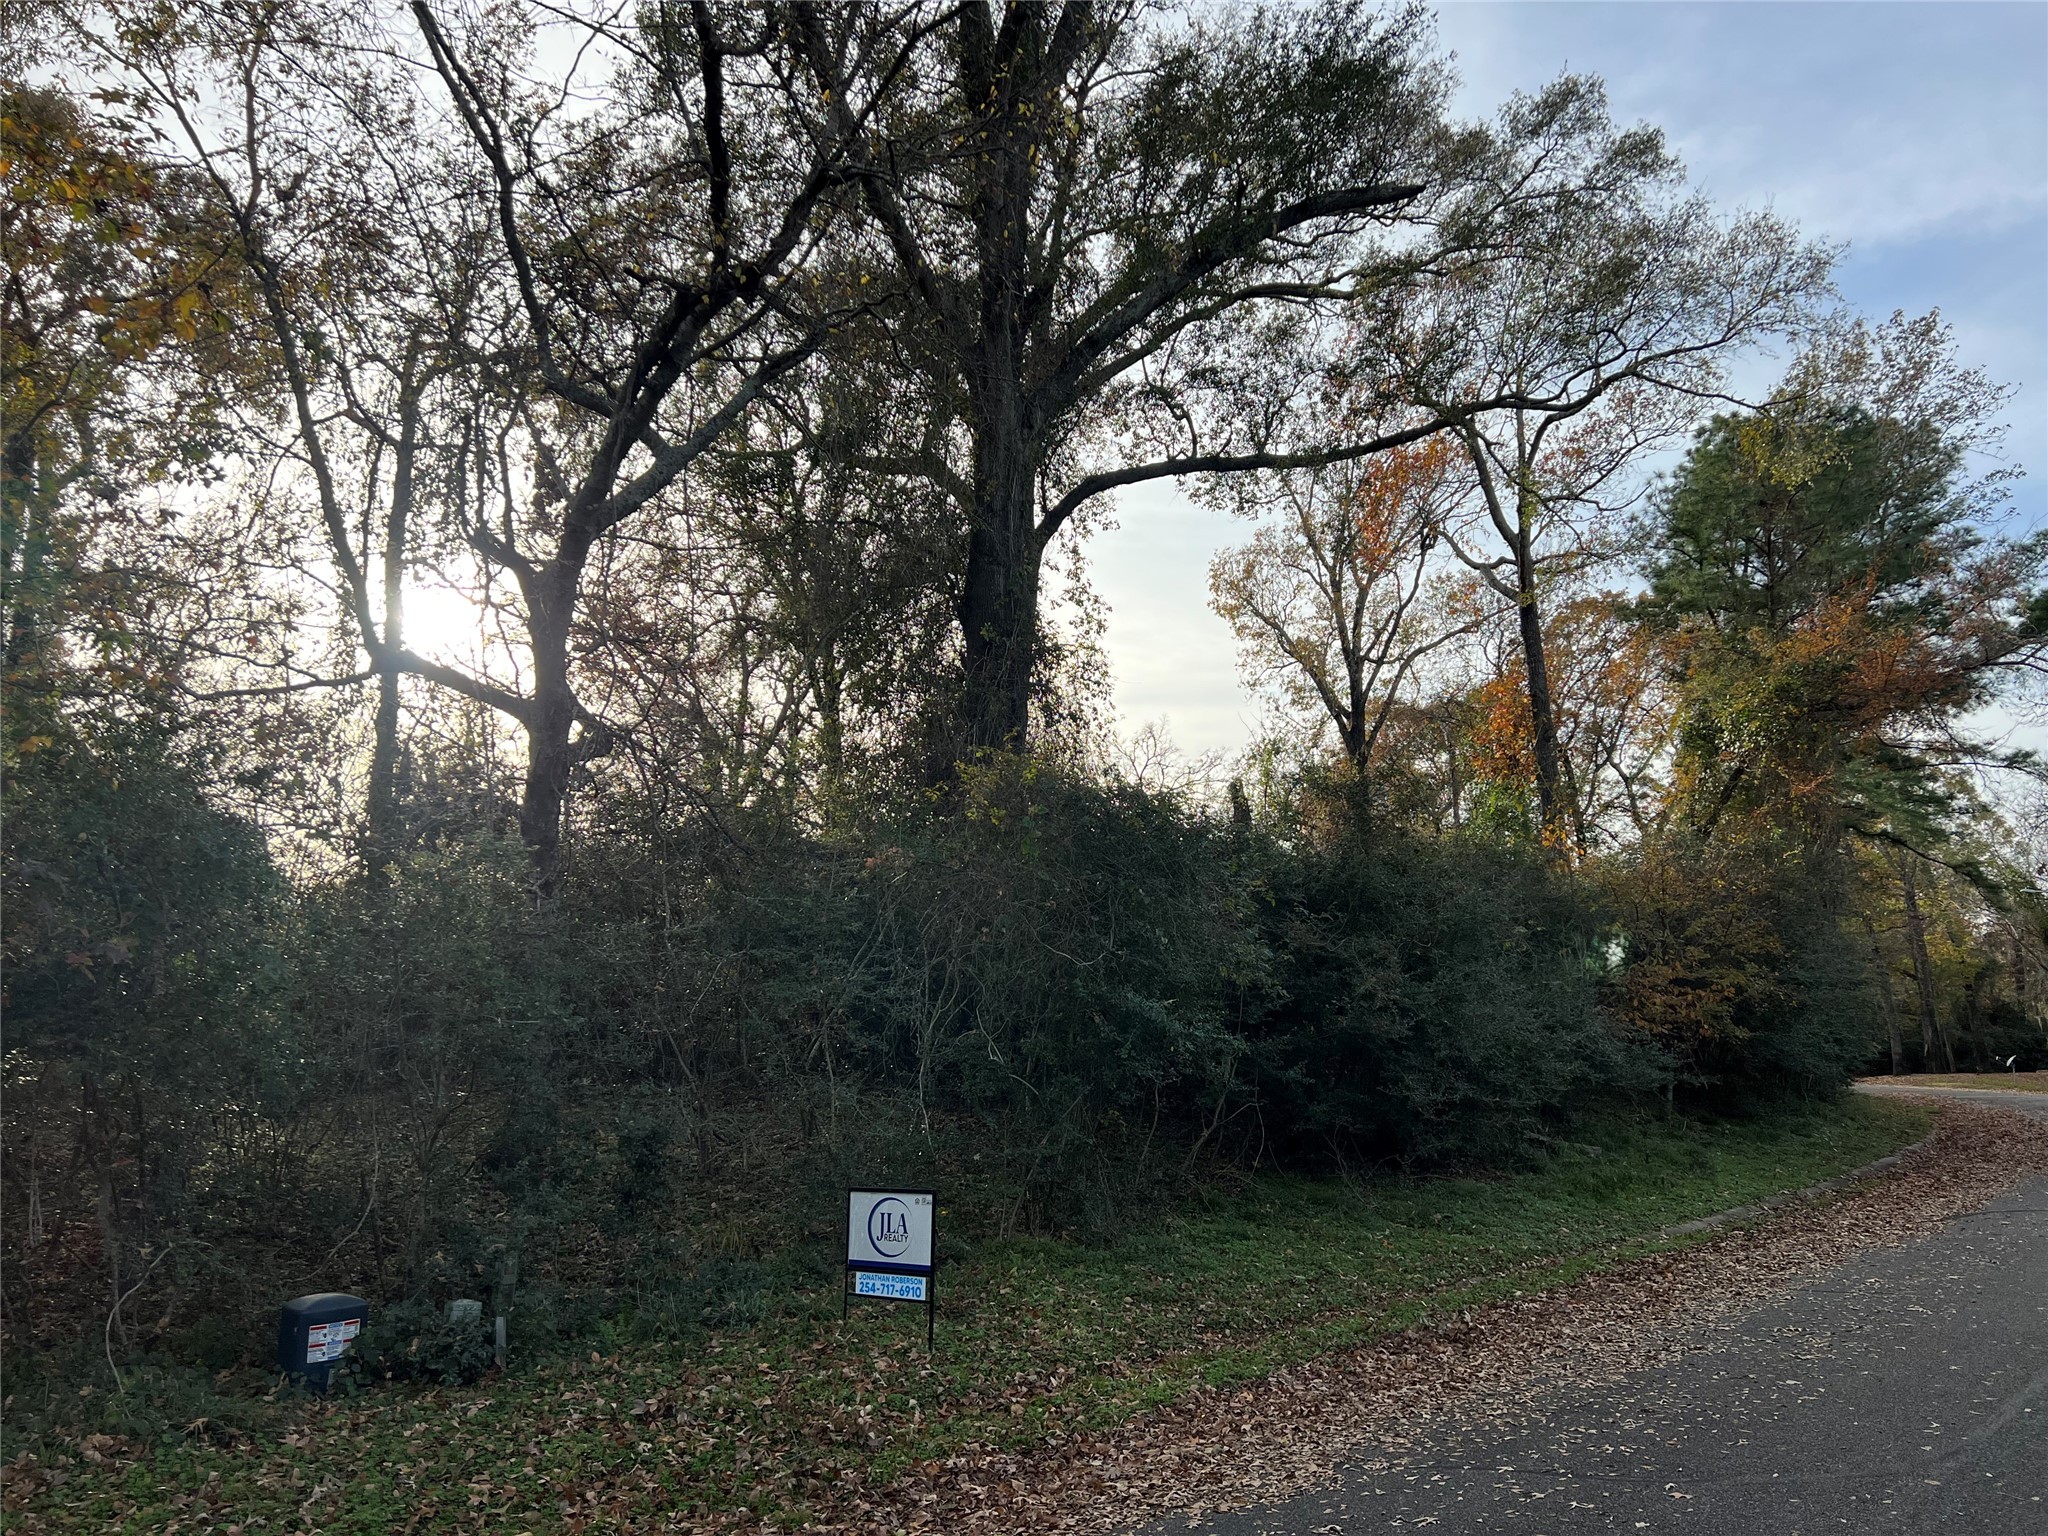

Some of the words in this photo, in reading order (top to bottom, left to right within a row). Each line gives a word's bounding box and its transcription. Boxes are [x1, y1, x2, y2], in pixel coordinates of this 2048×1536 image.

[877, 1213, 908, 1241] JLA
[884, 1234, 908, 1242] REALTY
[859, 1274, 890, 1282] JONATHAN
[891, 1277, 922, 1285] ROBERSON
[859, 1282, 921, 1298] 254-717-6910
